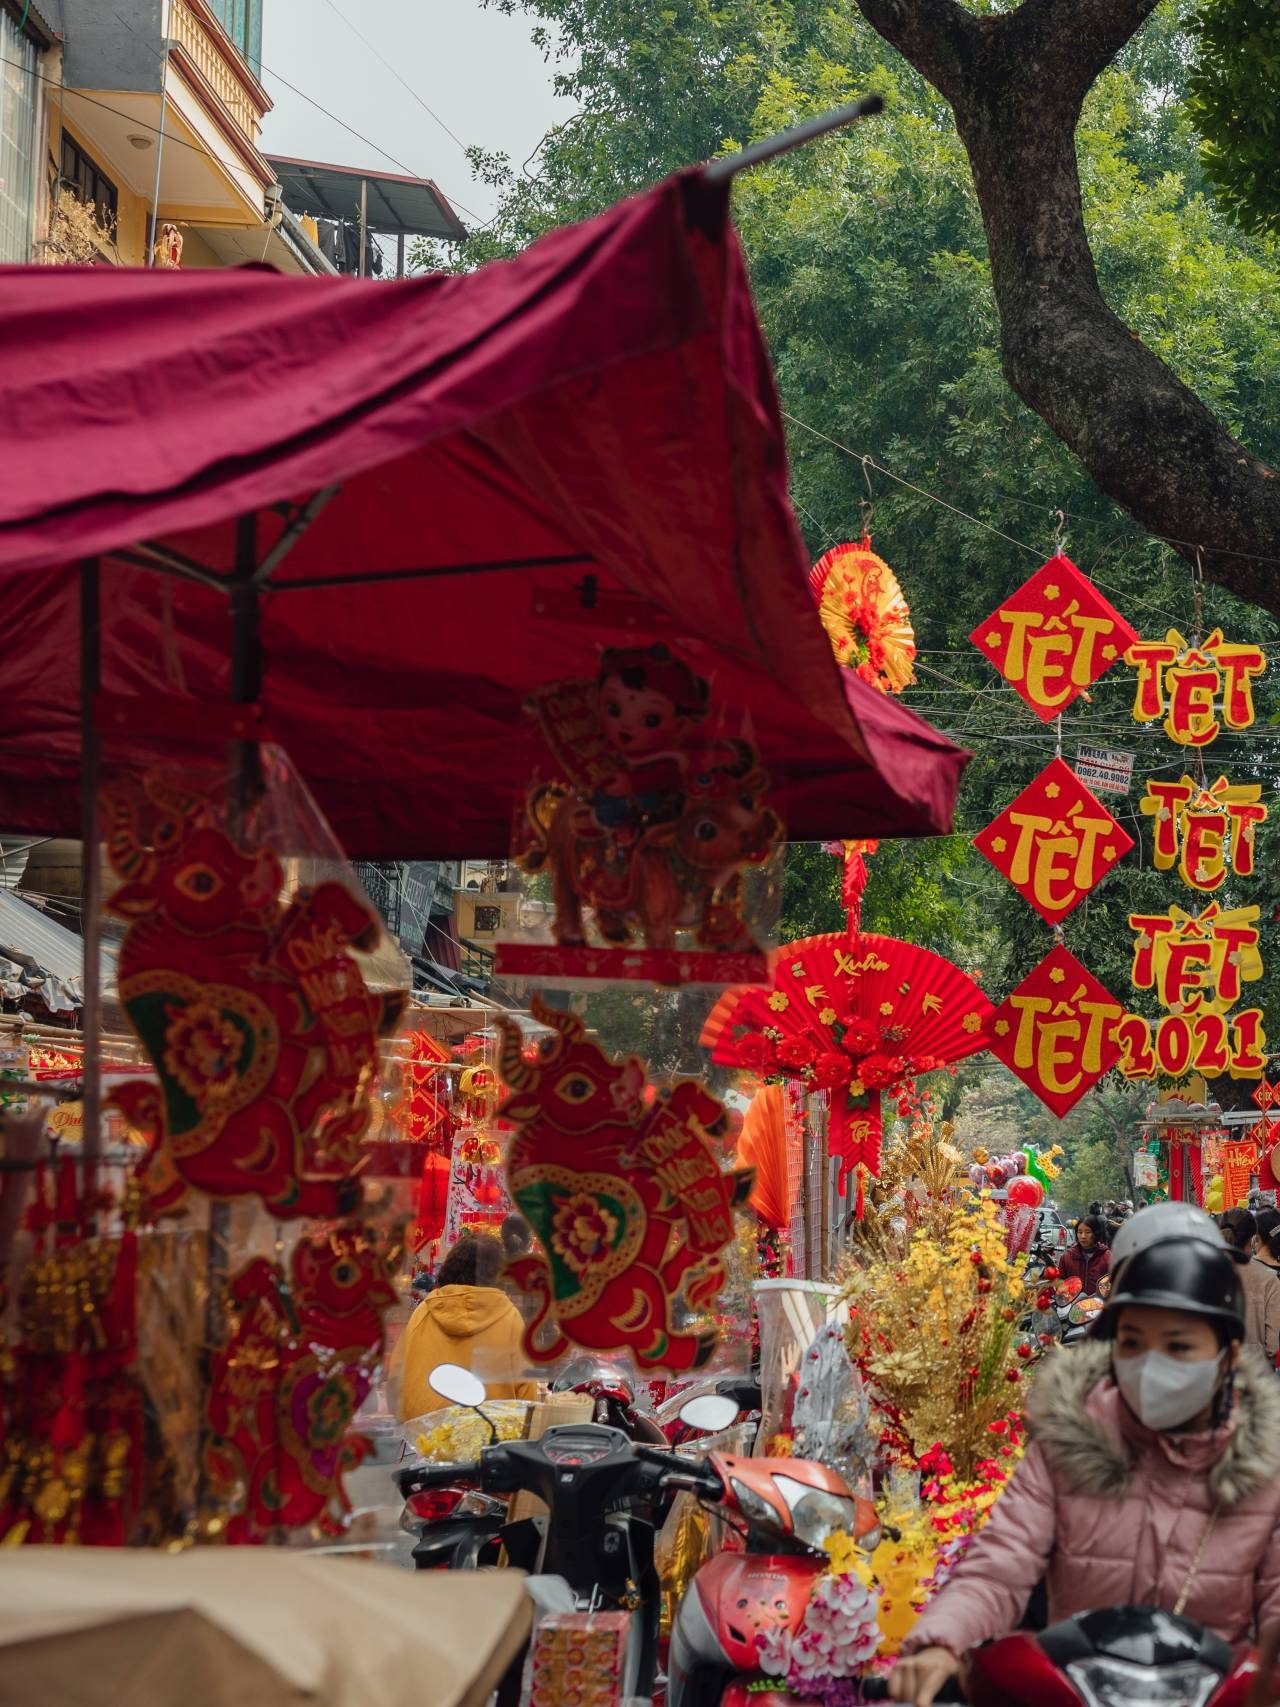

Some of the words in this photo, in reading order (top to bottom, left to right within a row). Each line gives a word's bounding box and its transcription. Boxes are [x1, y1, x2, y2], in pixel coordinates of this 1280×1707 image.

[999, 599, 1115, 707] TẾT
[1126, 629, 1266, 746] TẾT
[1010, 800, 1114, 910] TẾT
[1146, 776, 1268, 891] TẾT
[834, 949, 890, 977] Xuân
[1129, 899, 1264, 1016] TẾT
[1011, 984, 1122, 1094] TẾT
[1117, 1010, 1267, 1079] 2021
